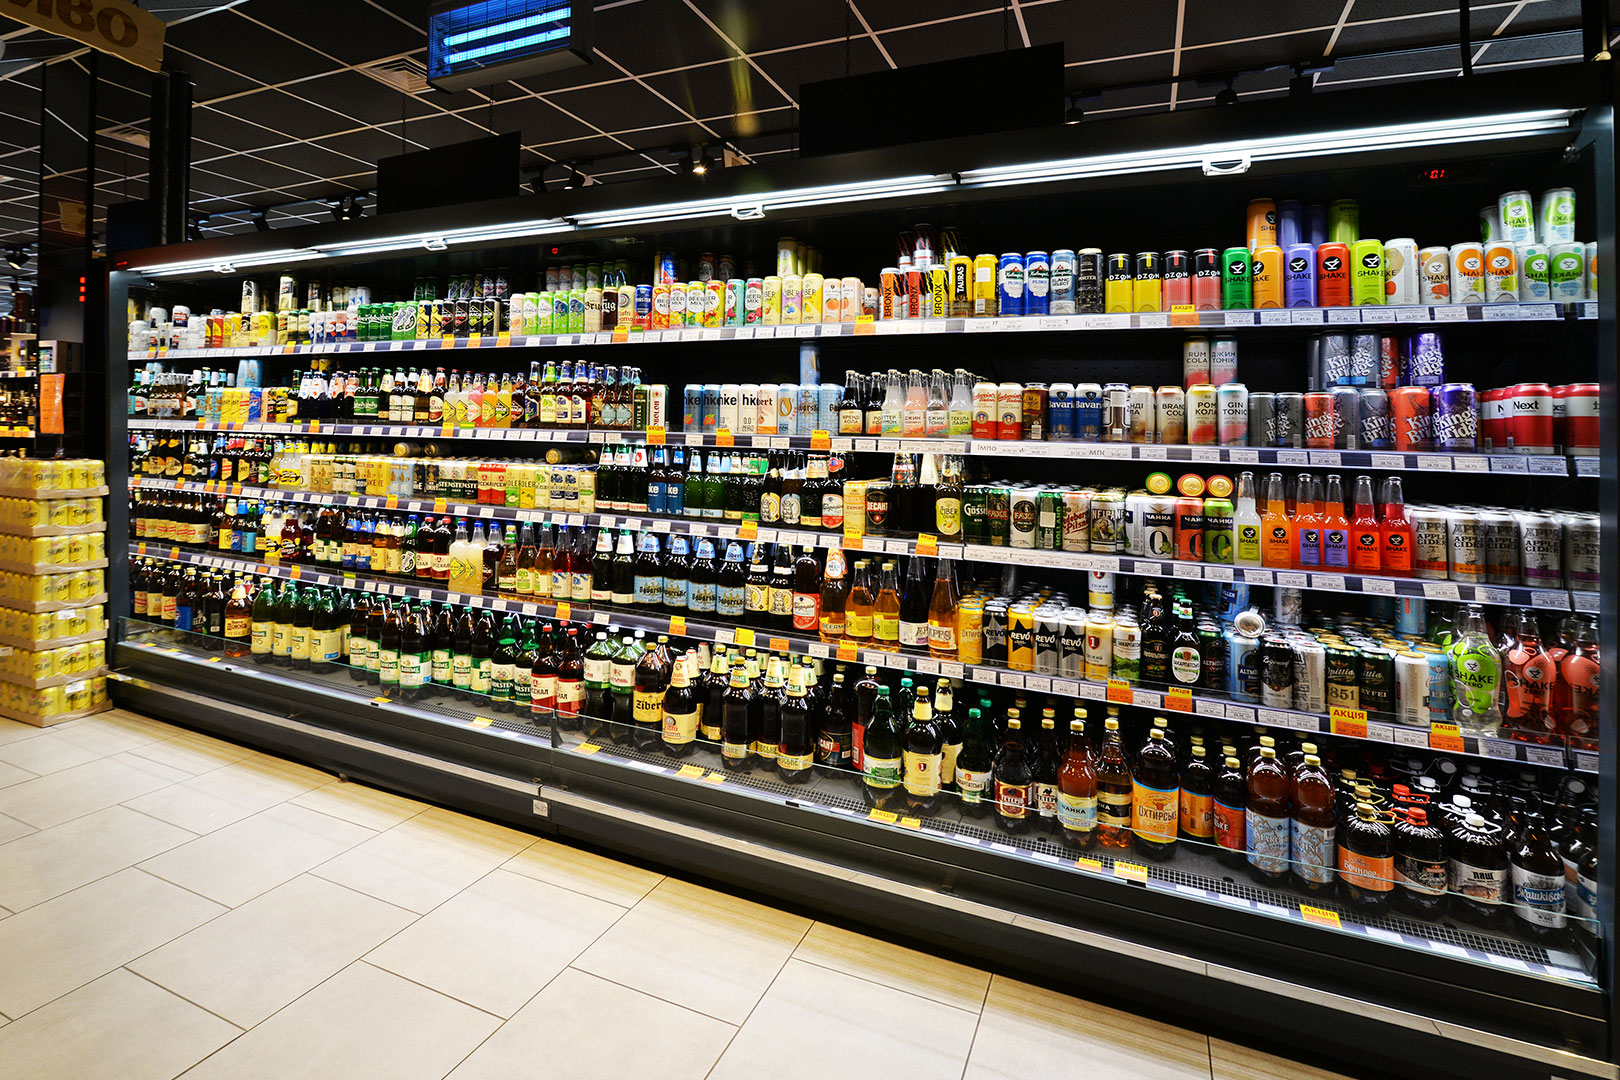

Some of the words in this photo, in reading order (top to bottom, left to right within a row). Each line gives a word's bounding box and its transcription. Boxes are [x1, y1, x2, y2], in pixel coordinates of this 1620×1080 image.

[1503, 218, 1533, 227] SHAKE
[956, 265, 965, 293] TAURAS
[1286, 273, 1312, 281] SHAKE
[1319, 272, 1347, 280] SHAKE
[884, 286, 892, 317] BRONX
[910, 285, 919, 316] BRONX
[934, 283, 943, 315] BRONX
[1513, 400, 1540, 410] Next
[1222, 408, 1248, 416] TONIC
[1524, 527, 1561, 541] APPS
[1525, 540, 1560, 548] APPLE
[1525, 546, 1560, 554] CIDER
[1454, 668, 1495, 685] SHAKE
[1512, 677, 1554, 691] SHAKE
[1333, 709, 1365, 720] АКЦІЯ
[1434, 723, 1457, 731] АКЦІЯ
[1138, 806, 1177, 822] ОХТИРСЬКЕ
[1118, 863, 1145, 873] АКЦІЯ
[1303, 906, 1336, 918] АКЦІЯ
